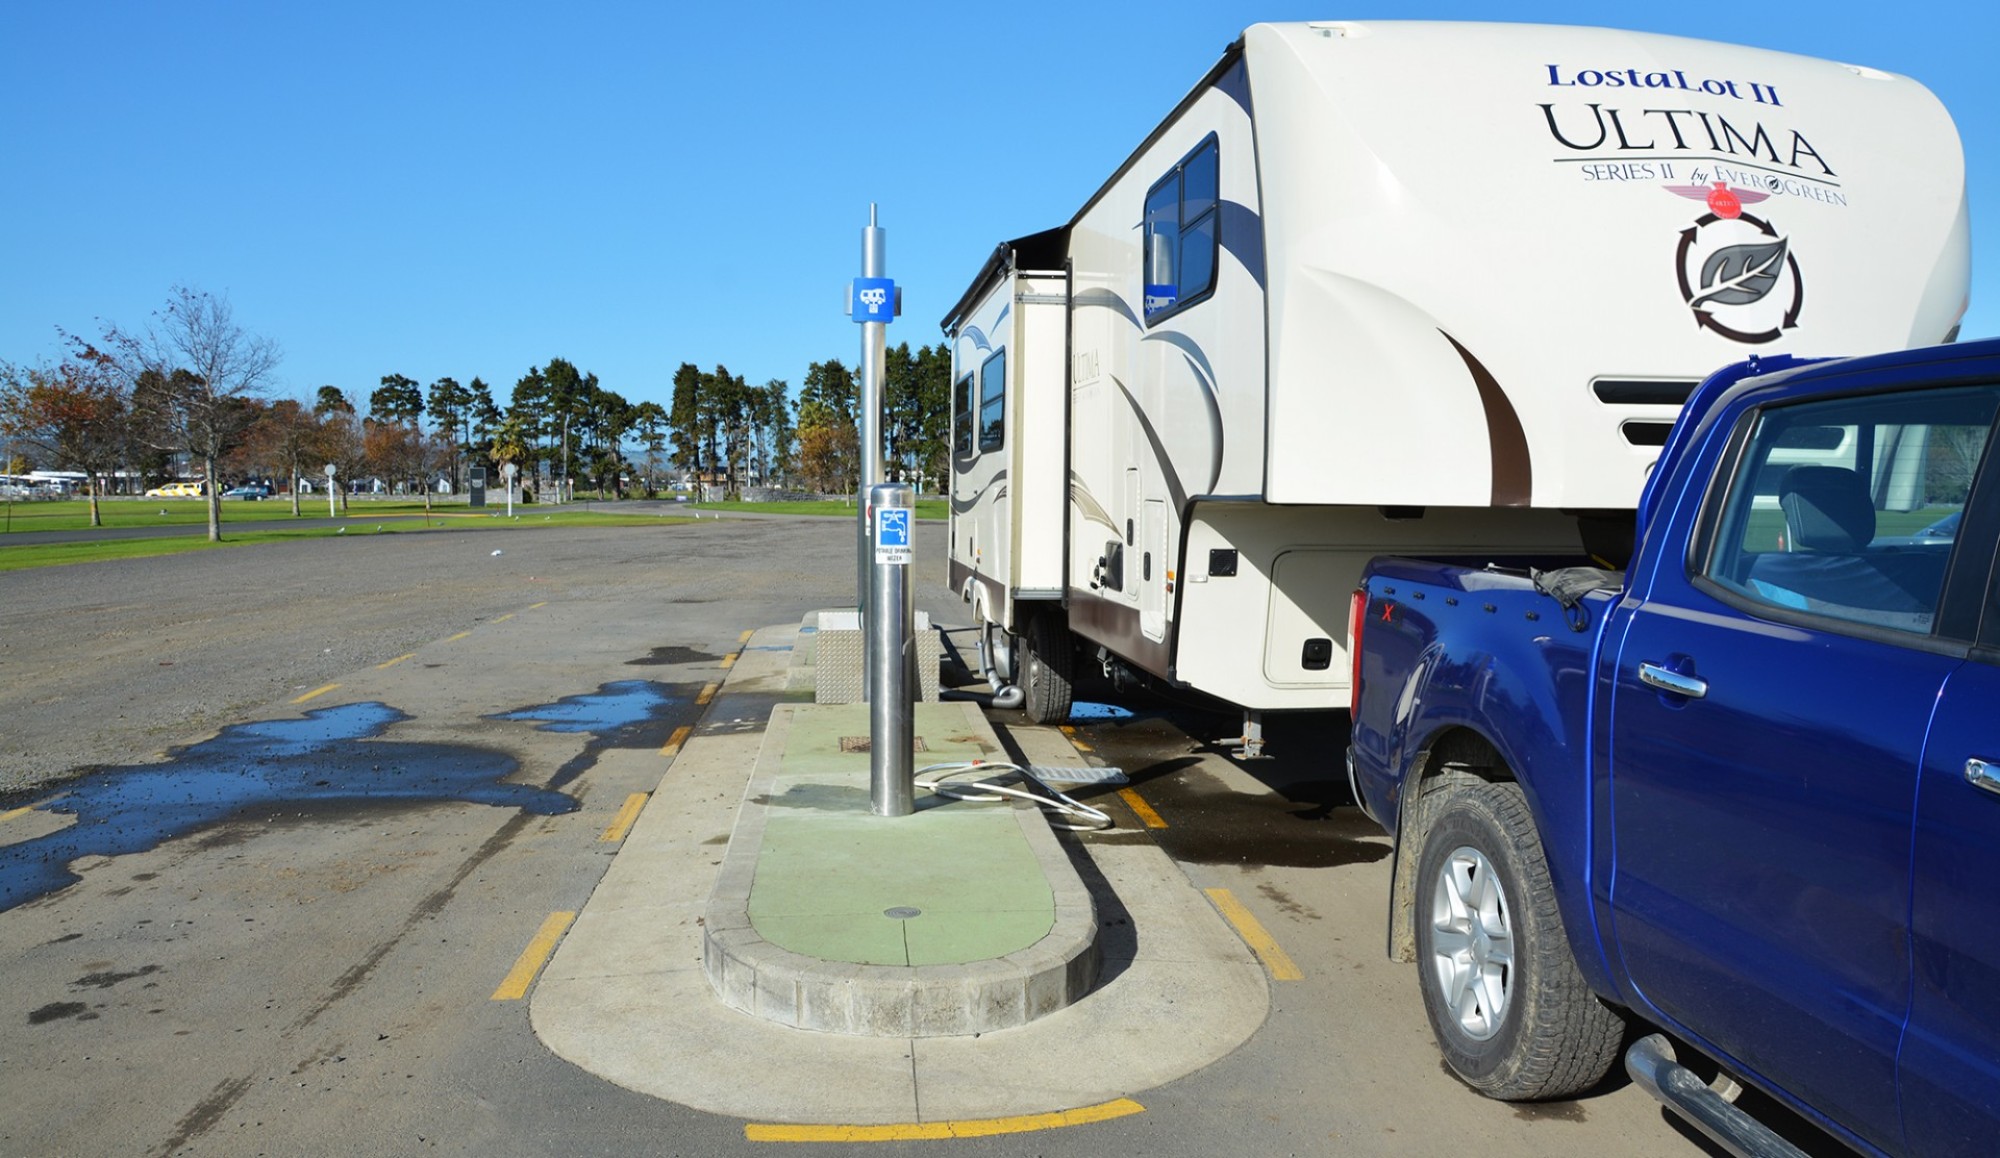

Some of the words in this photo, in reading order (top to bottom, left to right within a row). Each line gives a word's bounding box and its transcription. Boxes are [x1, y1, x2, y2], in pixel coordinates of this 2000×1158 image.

[1545, 64, 1743, 99] LostaLot
[1748, 82, 1784, 106] II
[1535, 103, 1837, 176] ULTIMA
[1581, 163, 1655, 181] SERIES
[1660, 163, 1674, 179] II
[1691, 166, 1708, 186] by
